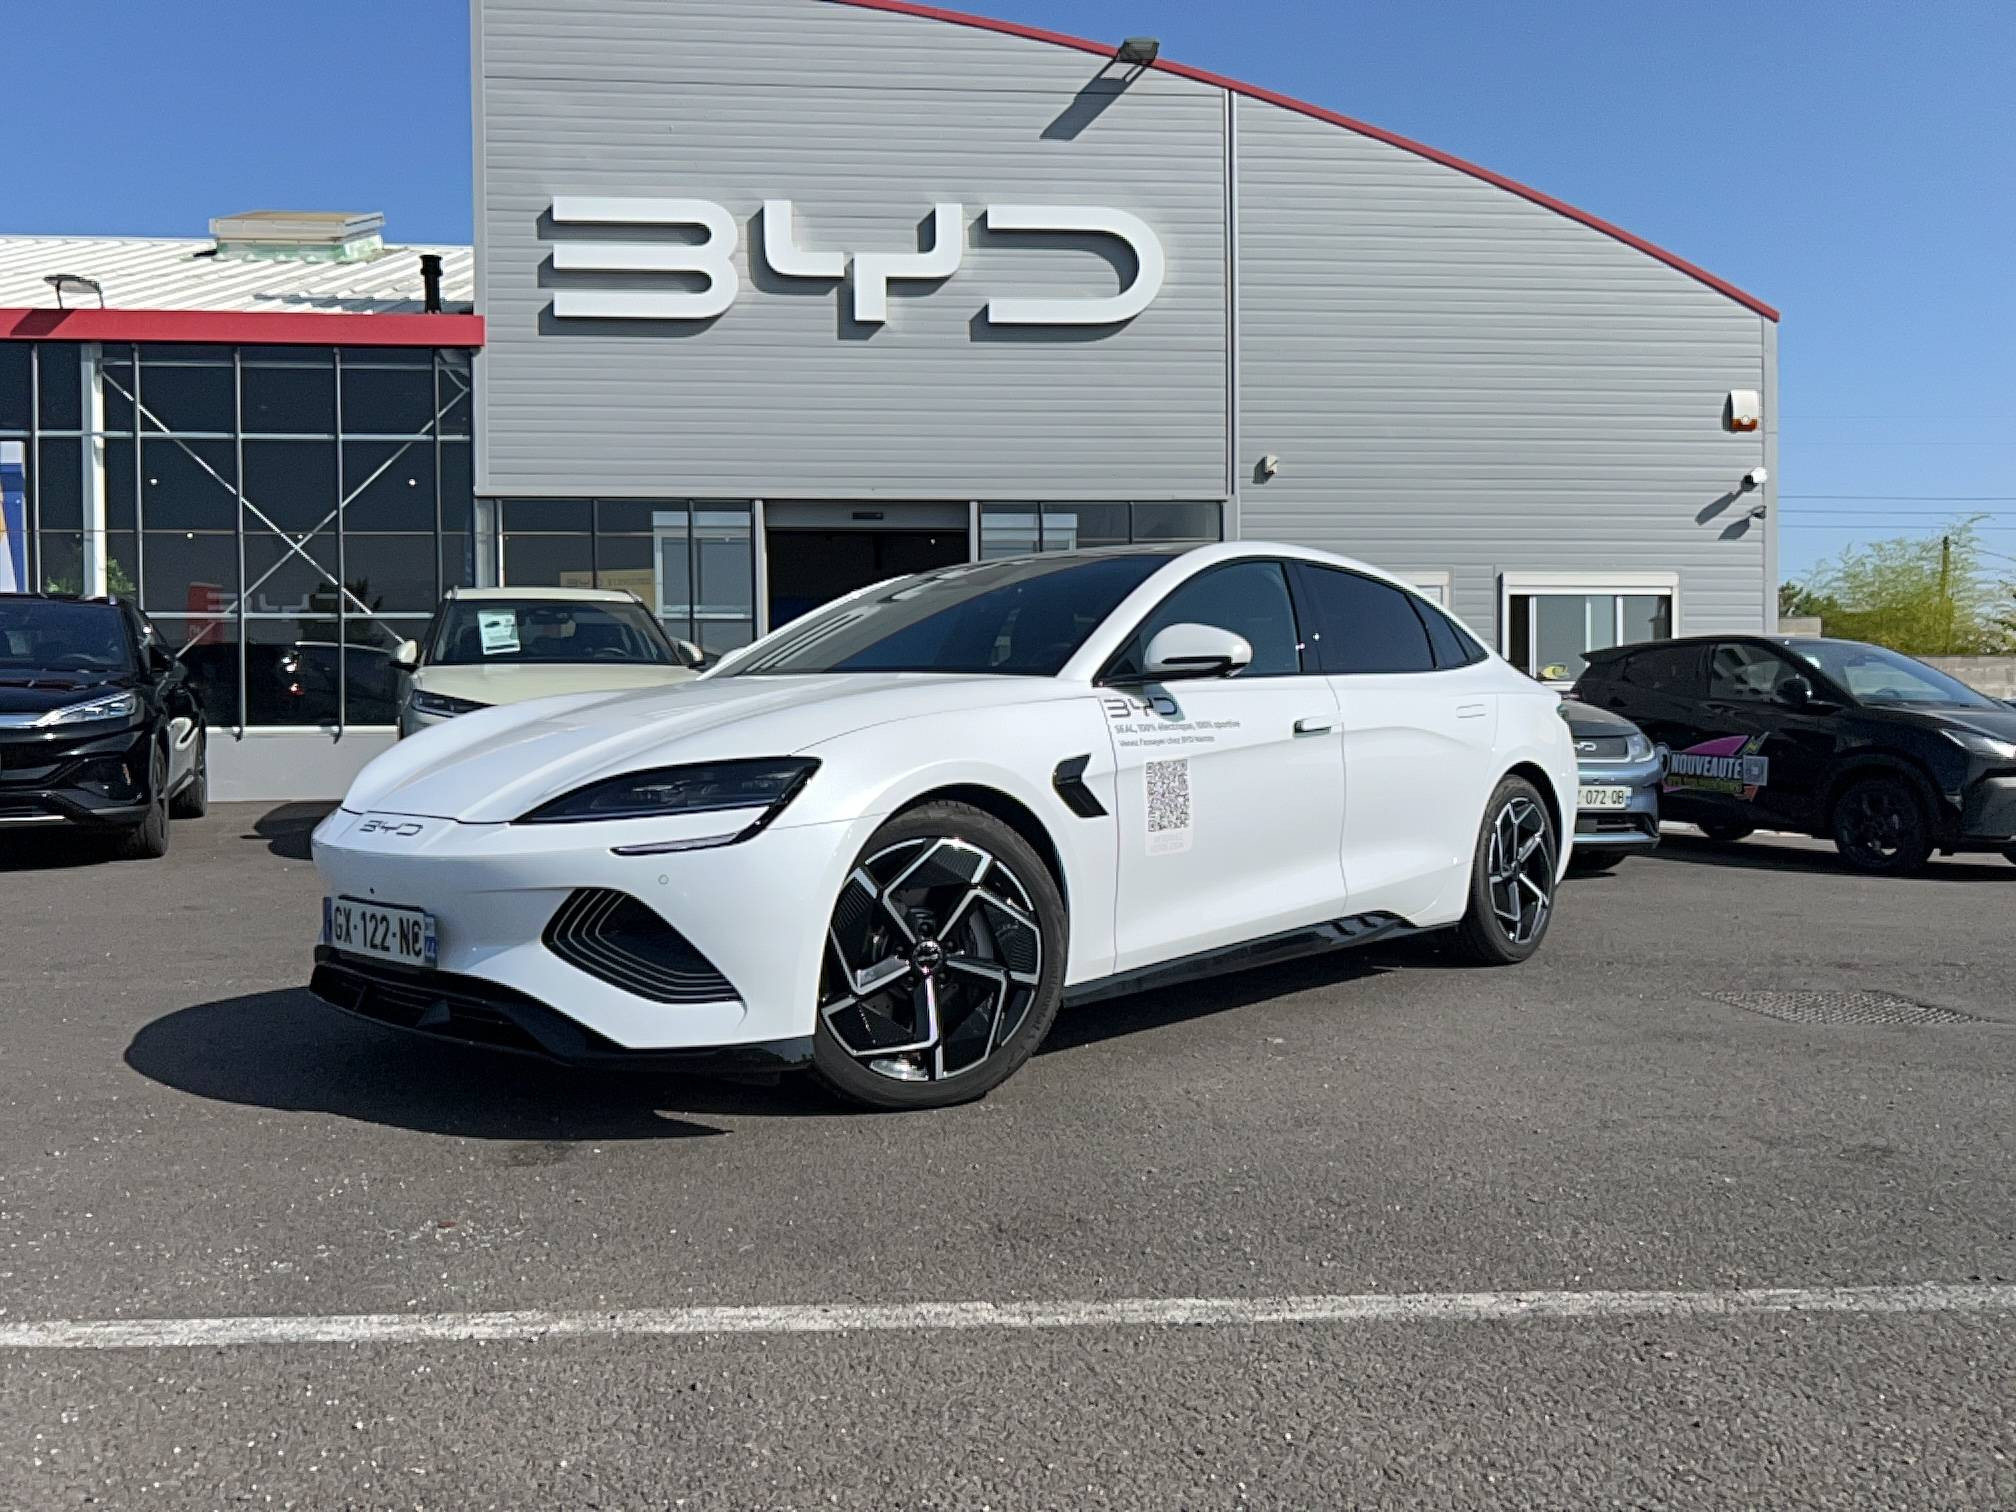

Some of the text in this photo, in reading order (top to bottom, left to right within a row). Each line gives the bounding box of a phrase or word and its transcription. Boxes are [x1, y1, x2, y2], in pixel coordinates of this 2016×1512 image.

[553, 197, 1166, 324] BYD
[1104, 697, 1178, 718] BYD
[360, 820, 424, 836] BYD
